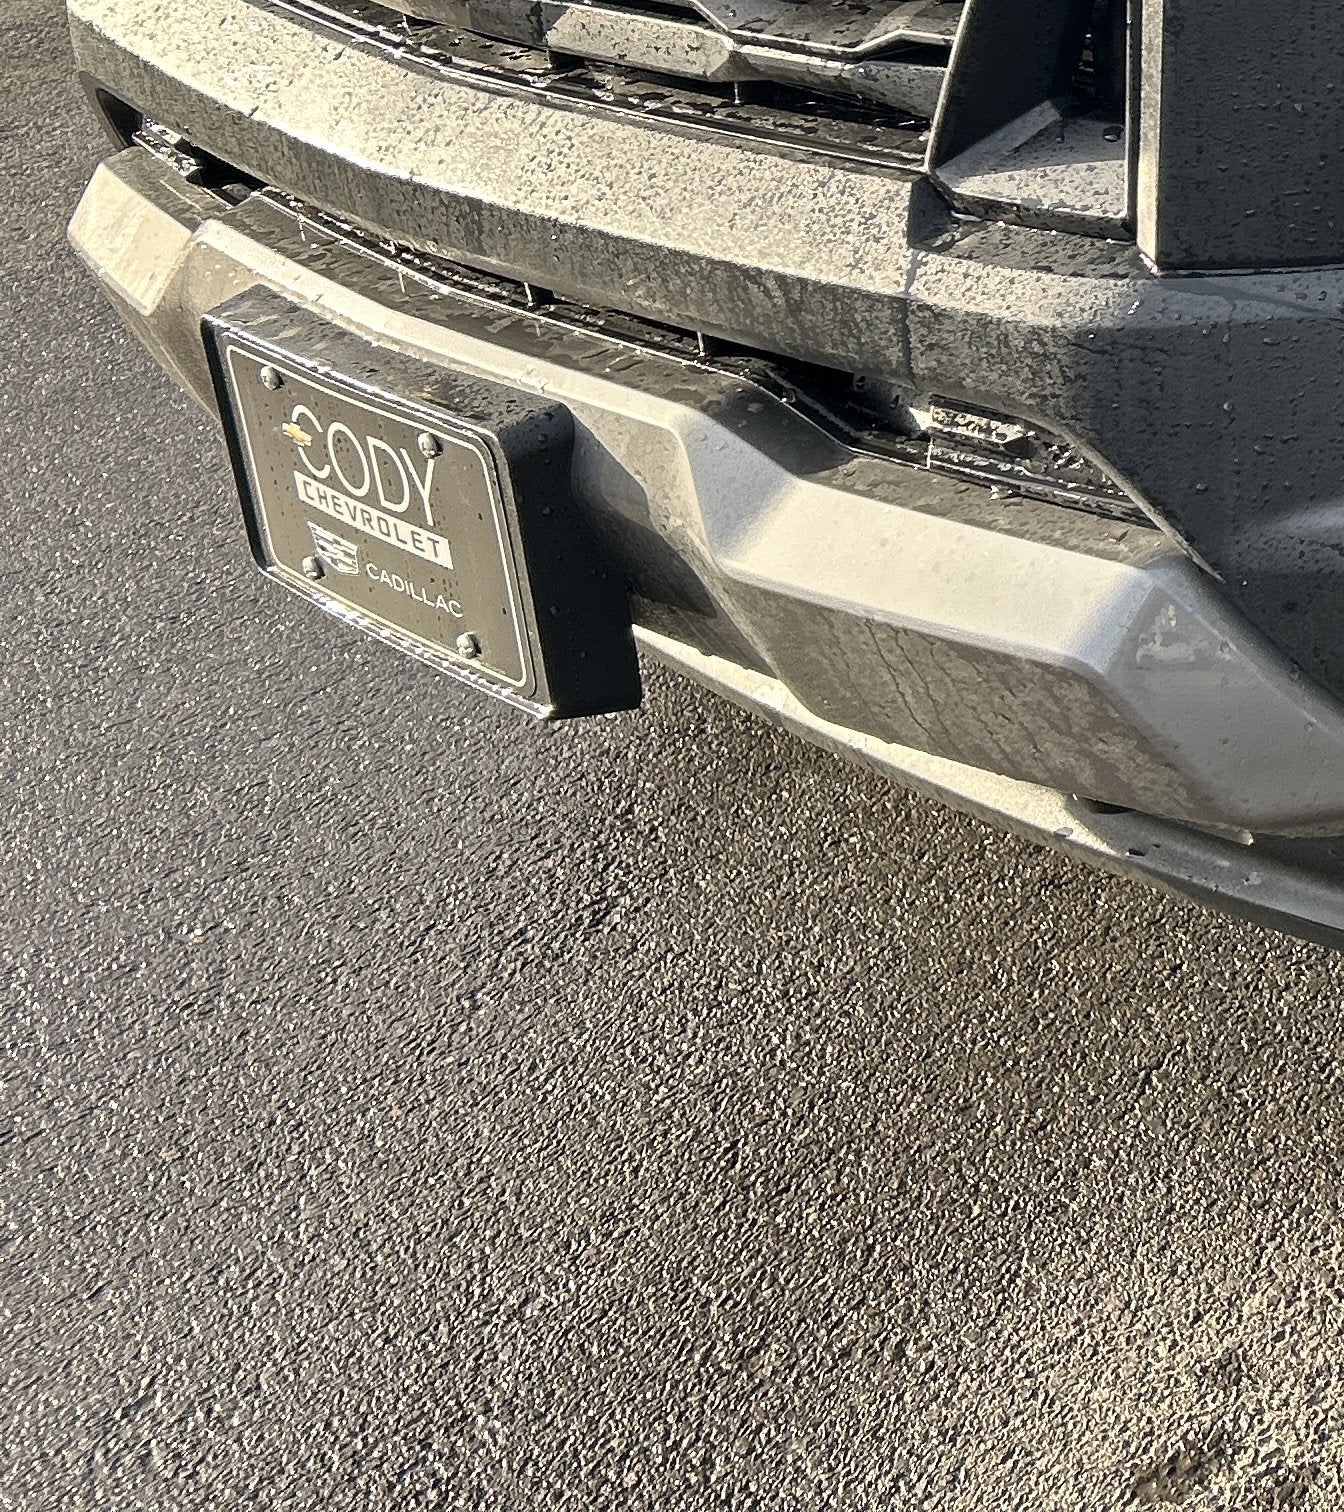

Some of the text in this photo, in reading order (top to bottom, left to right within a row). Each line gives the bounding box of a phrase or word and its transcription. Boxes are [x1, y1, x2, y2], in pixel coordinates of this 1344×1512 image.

[291, 404, 434, 527] CODY
[302, 479, 440, 559] CHEVROLET
[365, 562, 464, 619] CADILLAC
